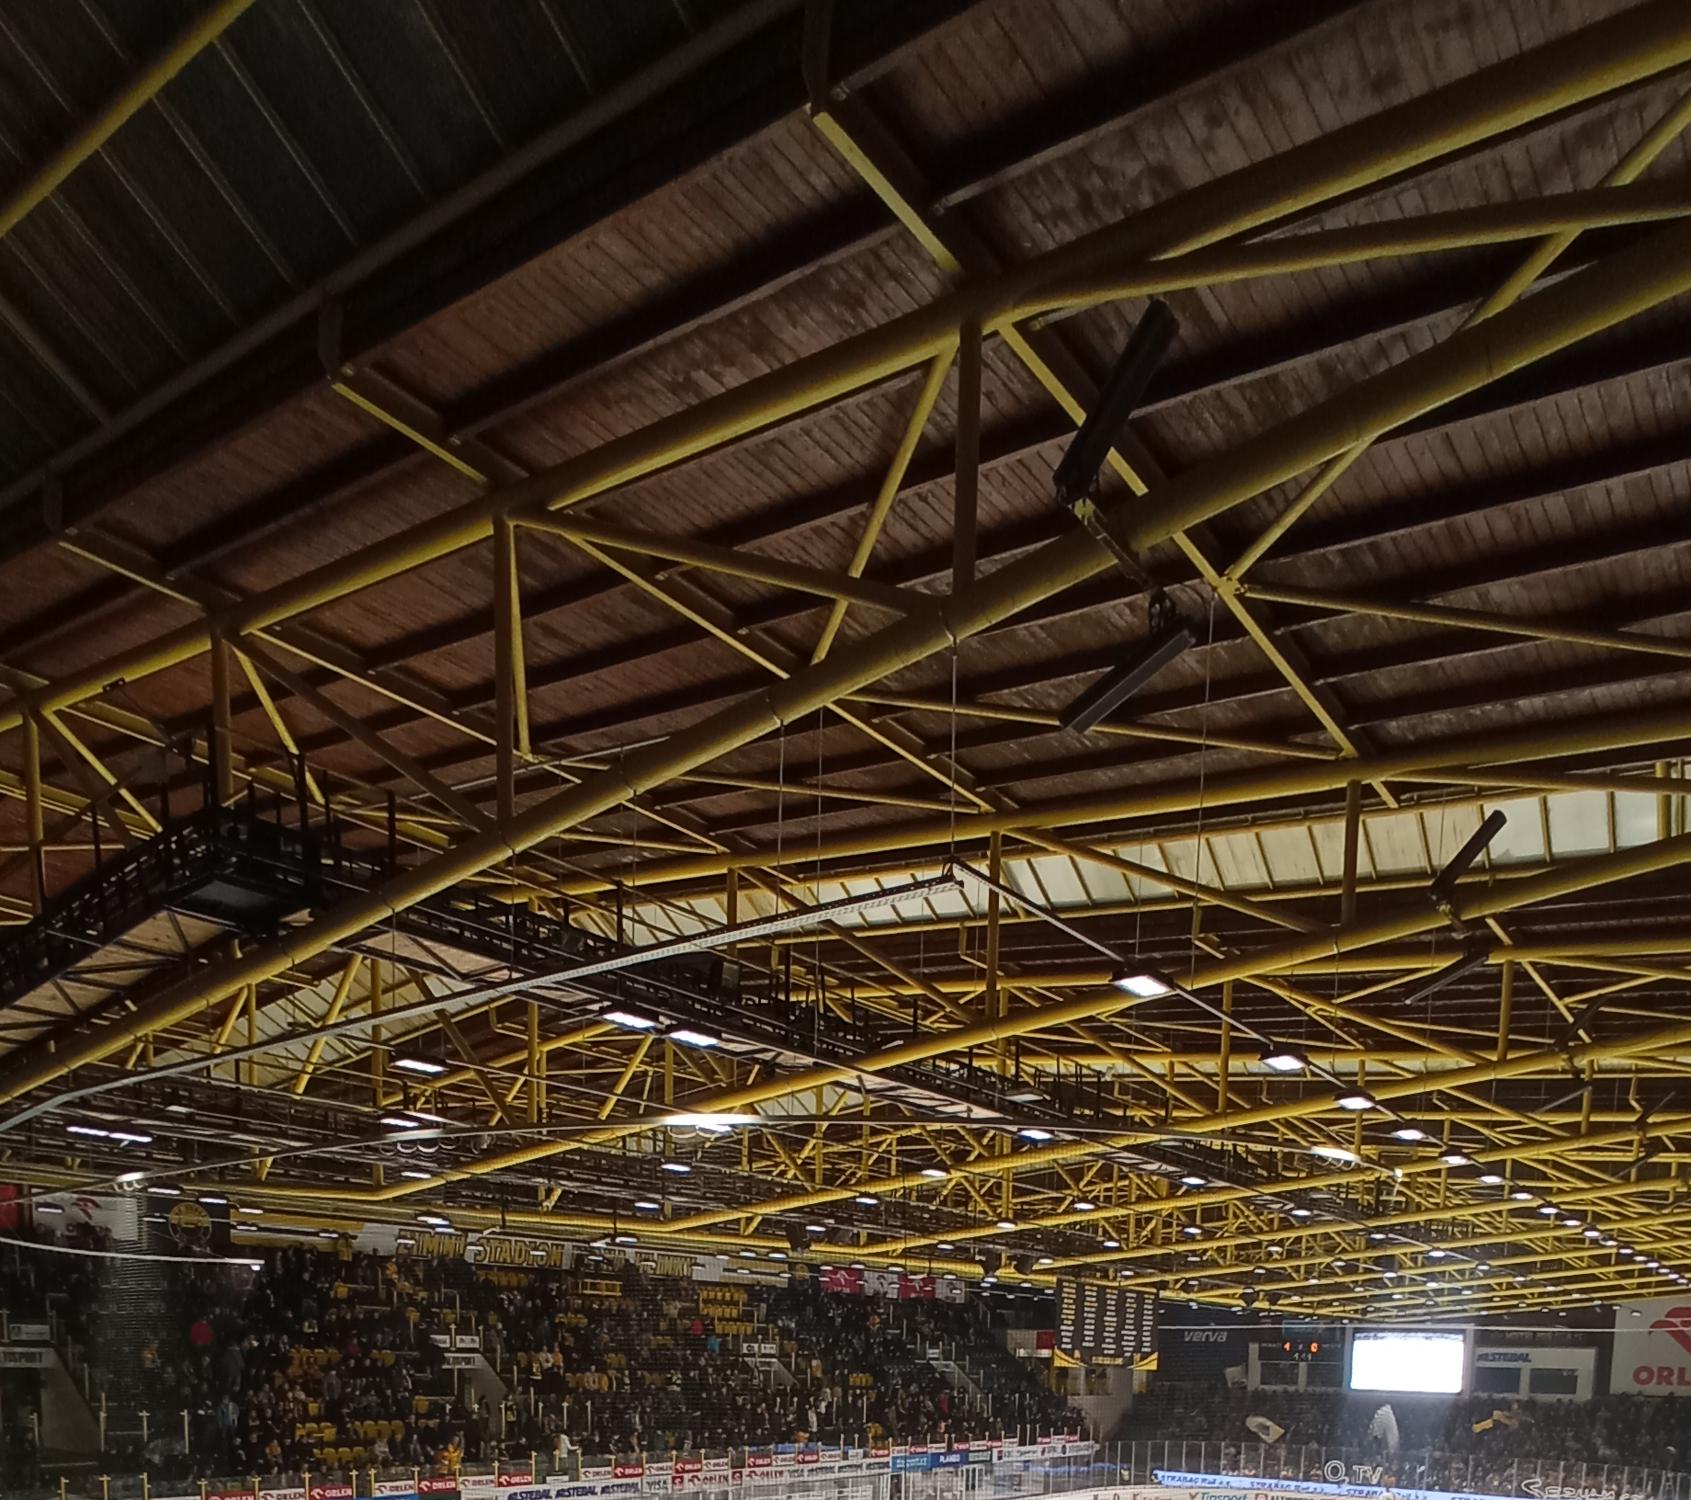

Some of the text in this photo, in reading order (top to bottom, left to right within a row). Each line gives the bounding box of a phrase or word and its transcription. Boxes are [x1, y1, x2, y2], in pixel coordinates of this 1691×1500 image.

[474, 1237, 565, 1267] STADION
[1184, 1330, 1228, 1342] verva
[1352, 1465, 1384, 1485] TV
[432, 1480, 456, 1491] ORLEN
[325, 1487, 352, 1498] ORLEN
